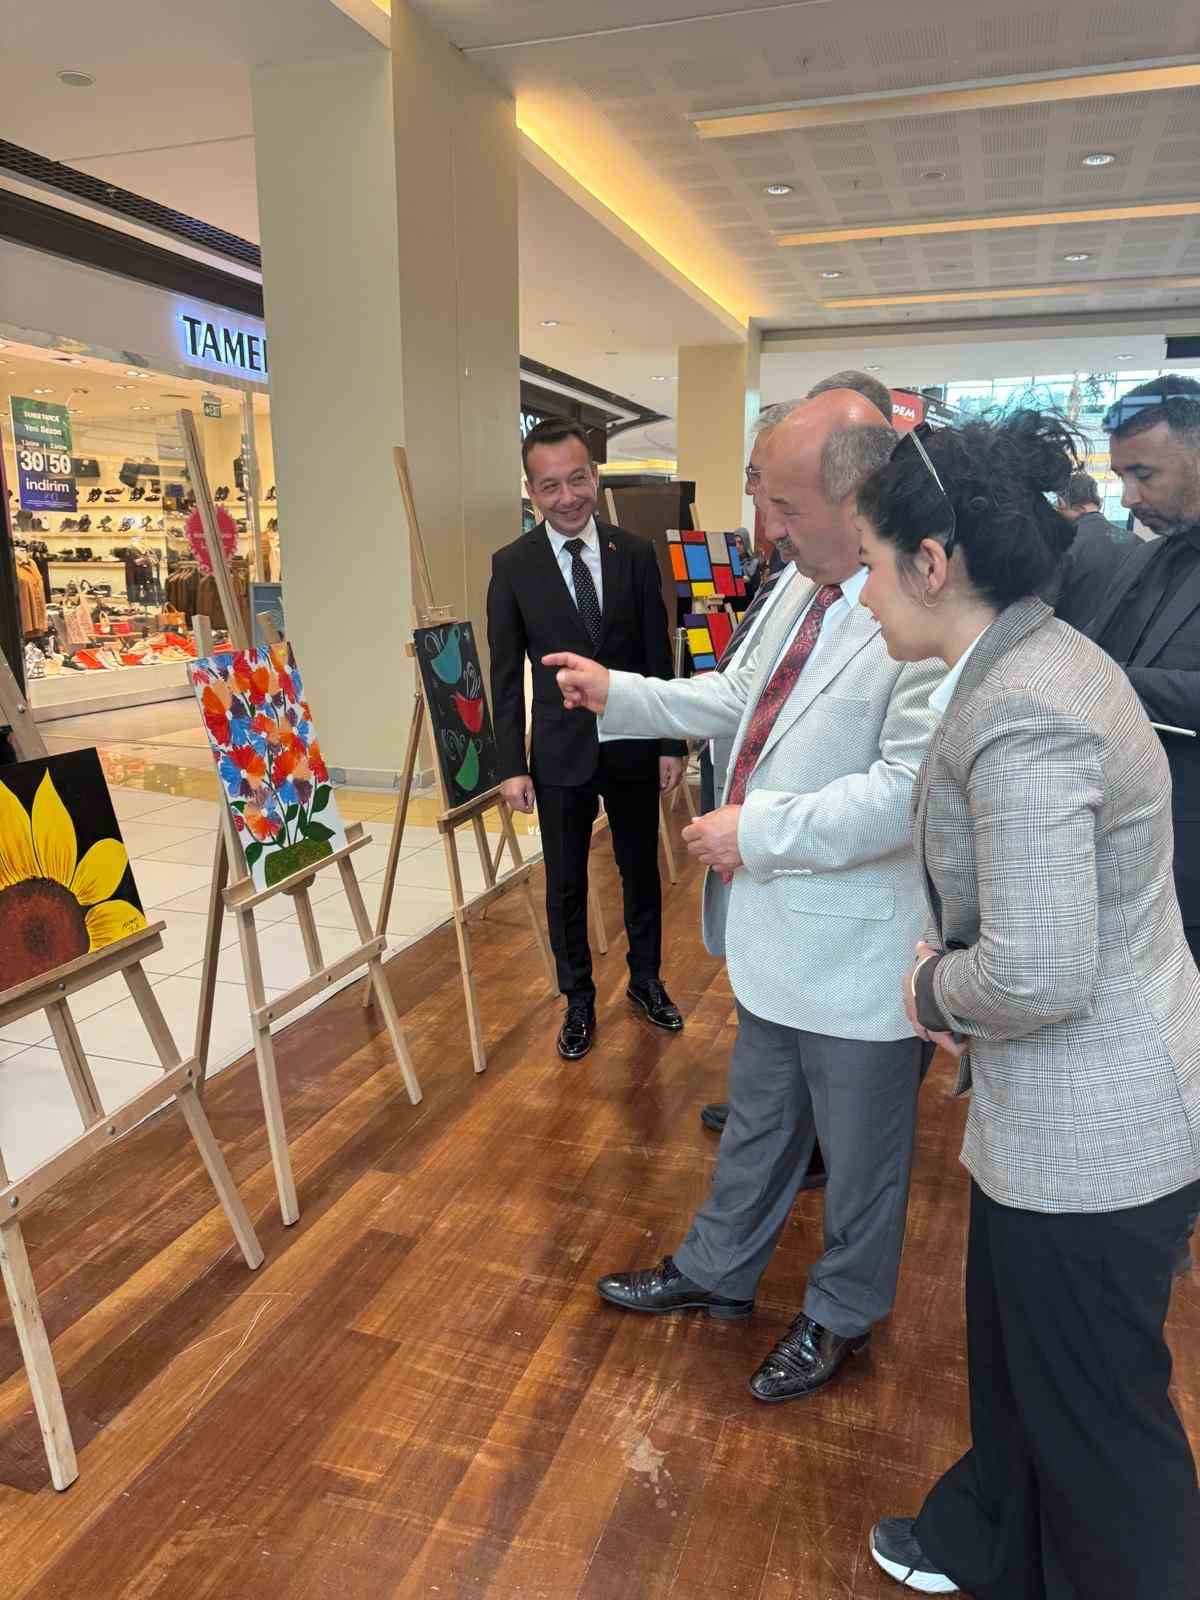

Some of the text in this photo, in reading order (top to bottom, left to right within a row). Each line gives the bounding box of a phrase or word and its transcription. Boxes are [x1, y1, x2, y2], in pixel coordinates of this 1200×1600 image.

[182, 315, 268, 373] TAME
[20, 450, 72, 475] 30 50
[25, 478, 70, 493] indirim
